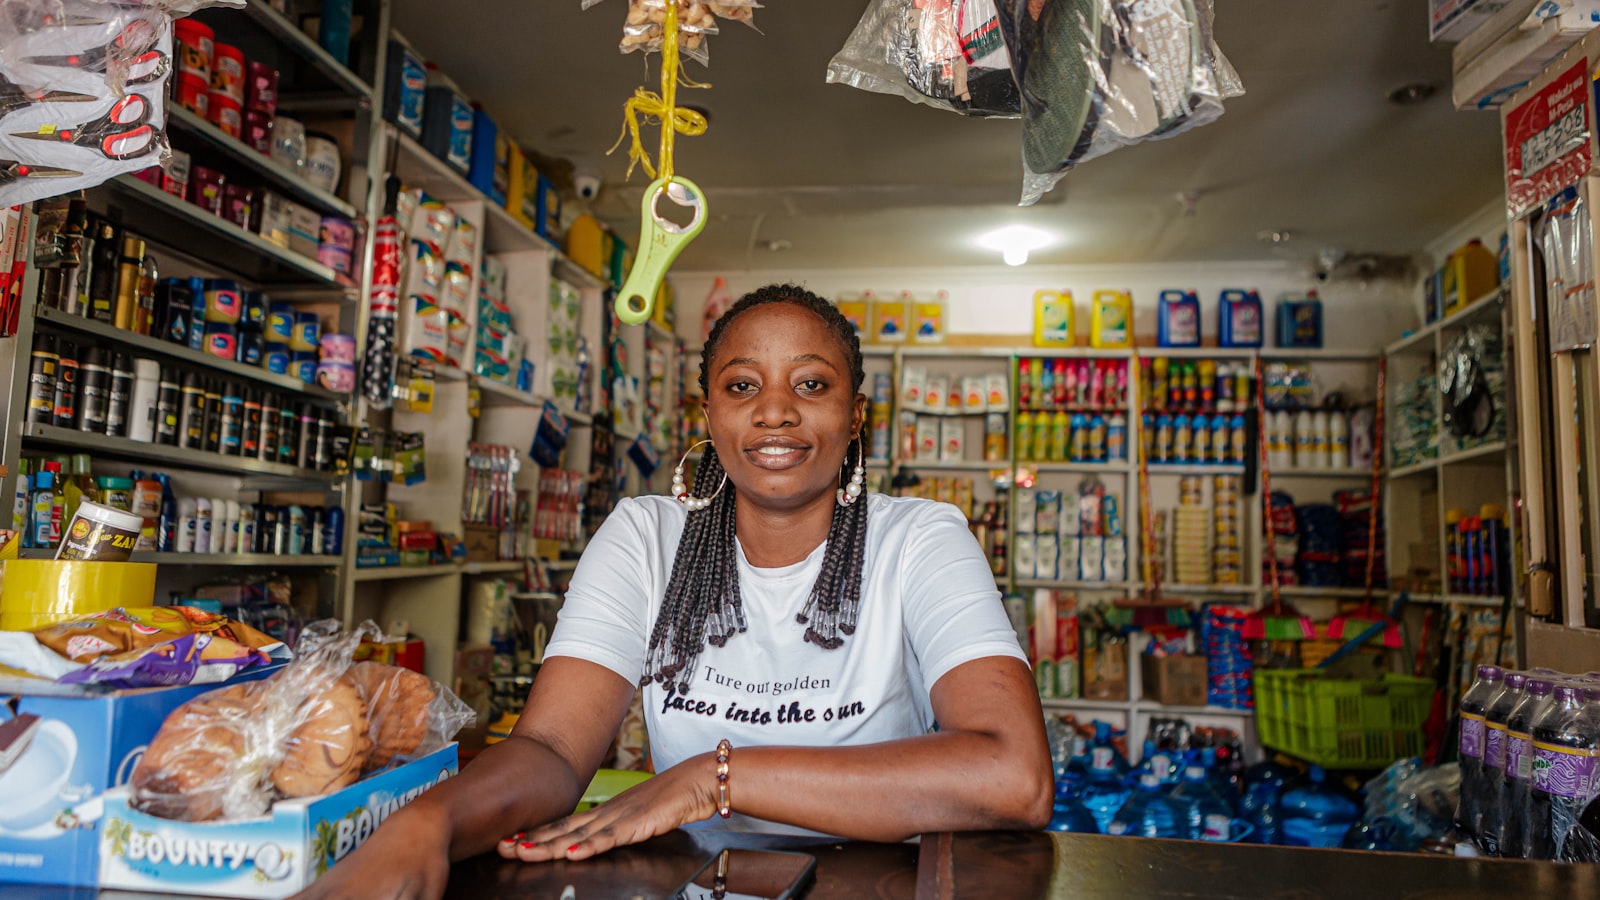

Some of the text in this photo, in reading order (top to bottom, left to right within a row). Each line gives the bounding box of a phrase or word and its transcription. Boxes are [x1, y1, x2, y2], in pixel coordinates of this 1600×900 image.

[704, 665, 742, 690] Ture
[772, 675, 831, 696] golden
[661, 687, 866, 725] faces into the sun
[128, 830, 249, 870] BOUNTY
